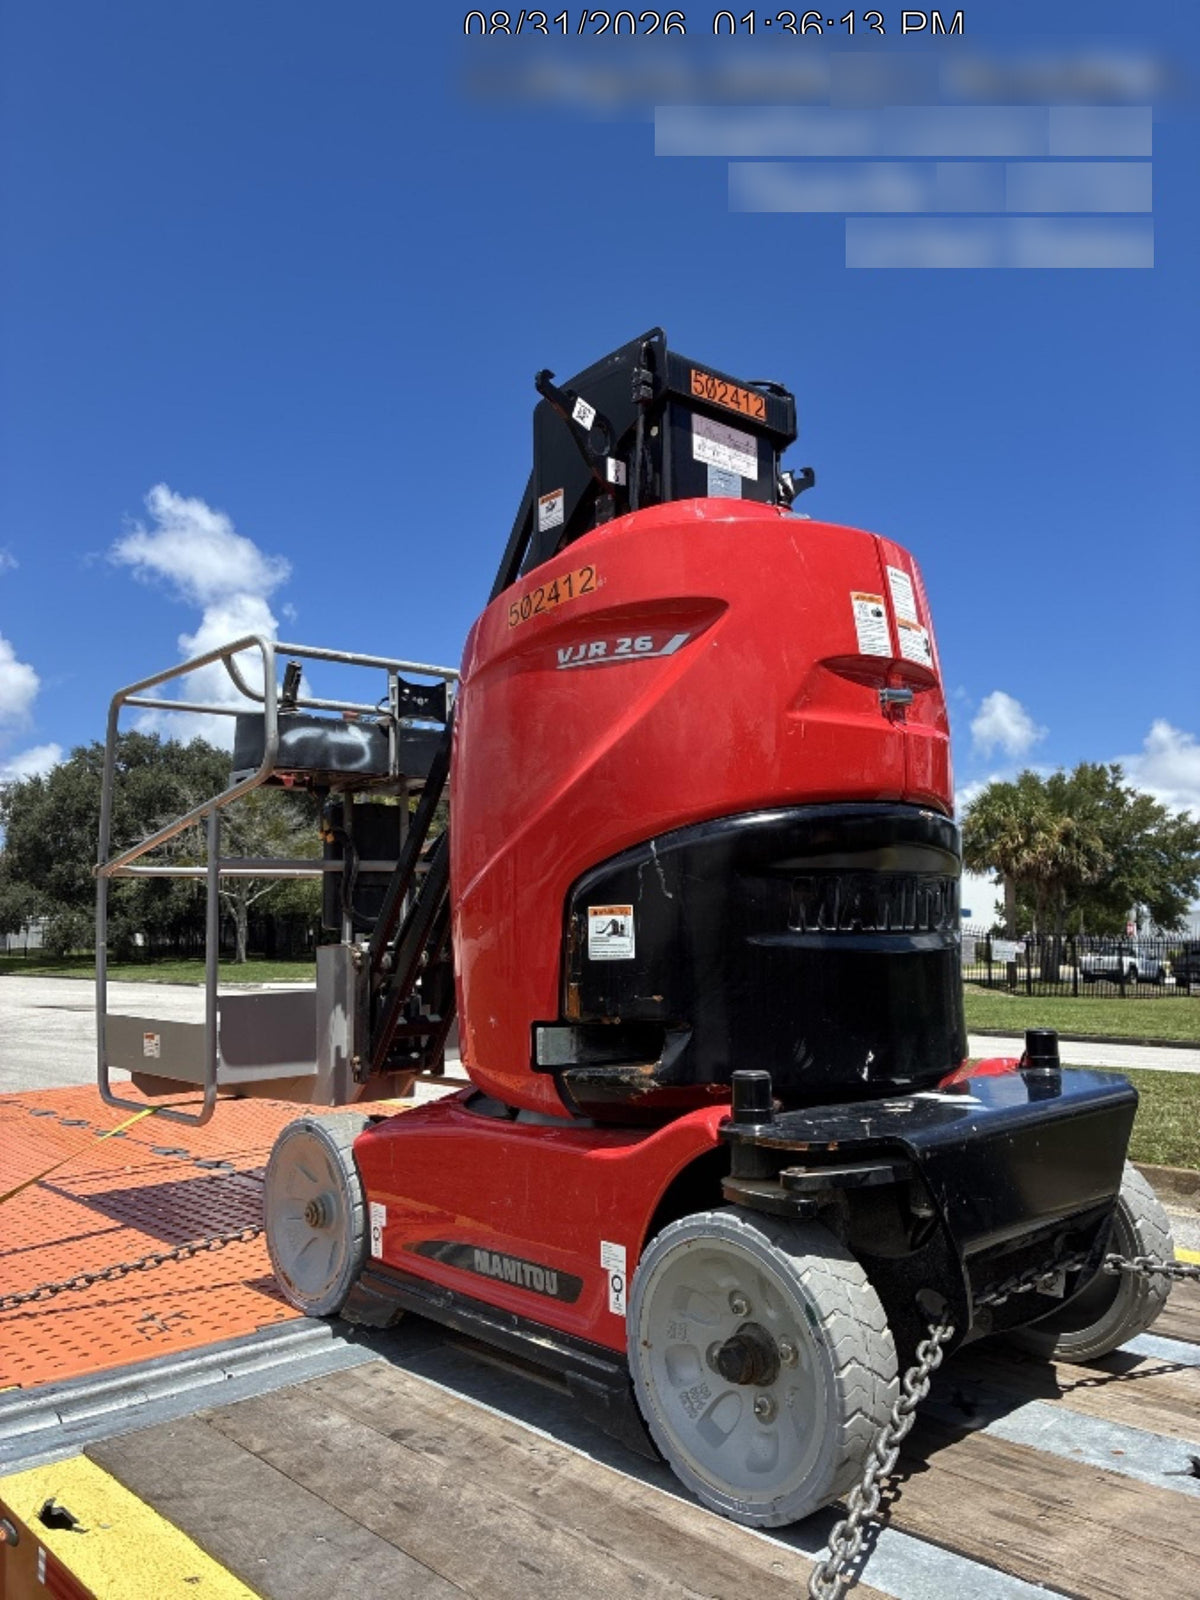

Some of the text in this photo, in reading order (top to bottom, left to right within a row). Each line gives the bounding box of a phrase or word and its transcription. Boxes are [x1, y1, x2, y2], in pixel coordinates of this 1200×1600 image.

[692, 371, 765, 419] 502412
[508, 566, 595, 626] 502412
[557, 636, 654, 664] VJR 26
[474, 1249, 558, 1296] MANITOU
